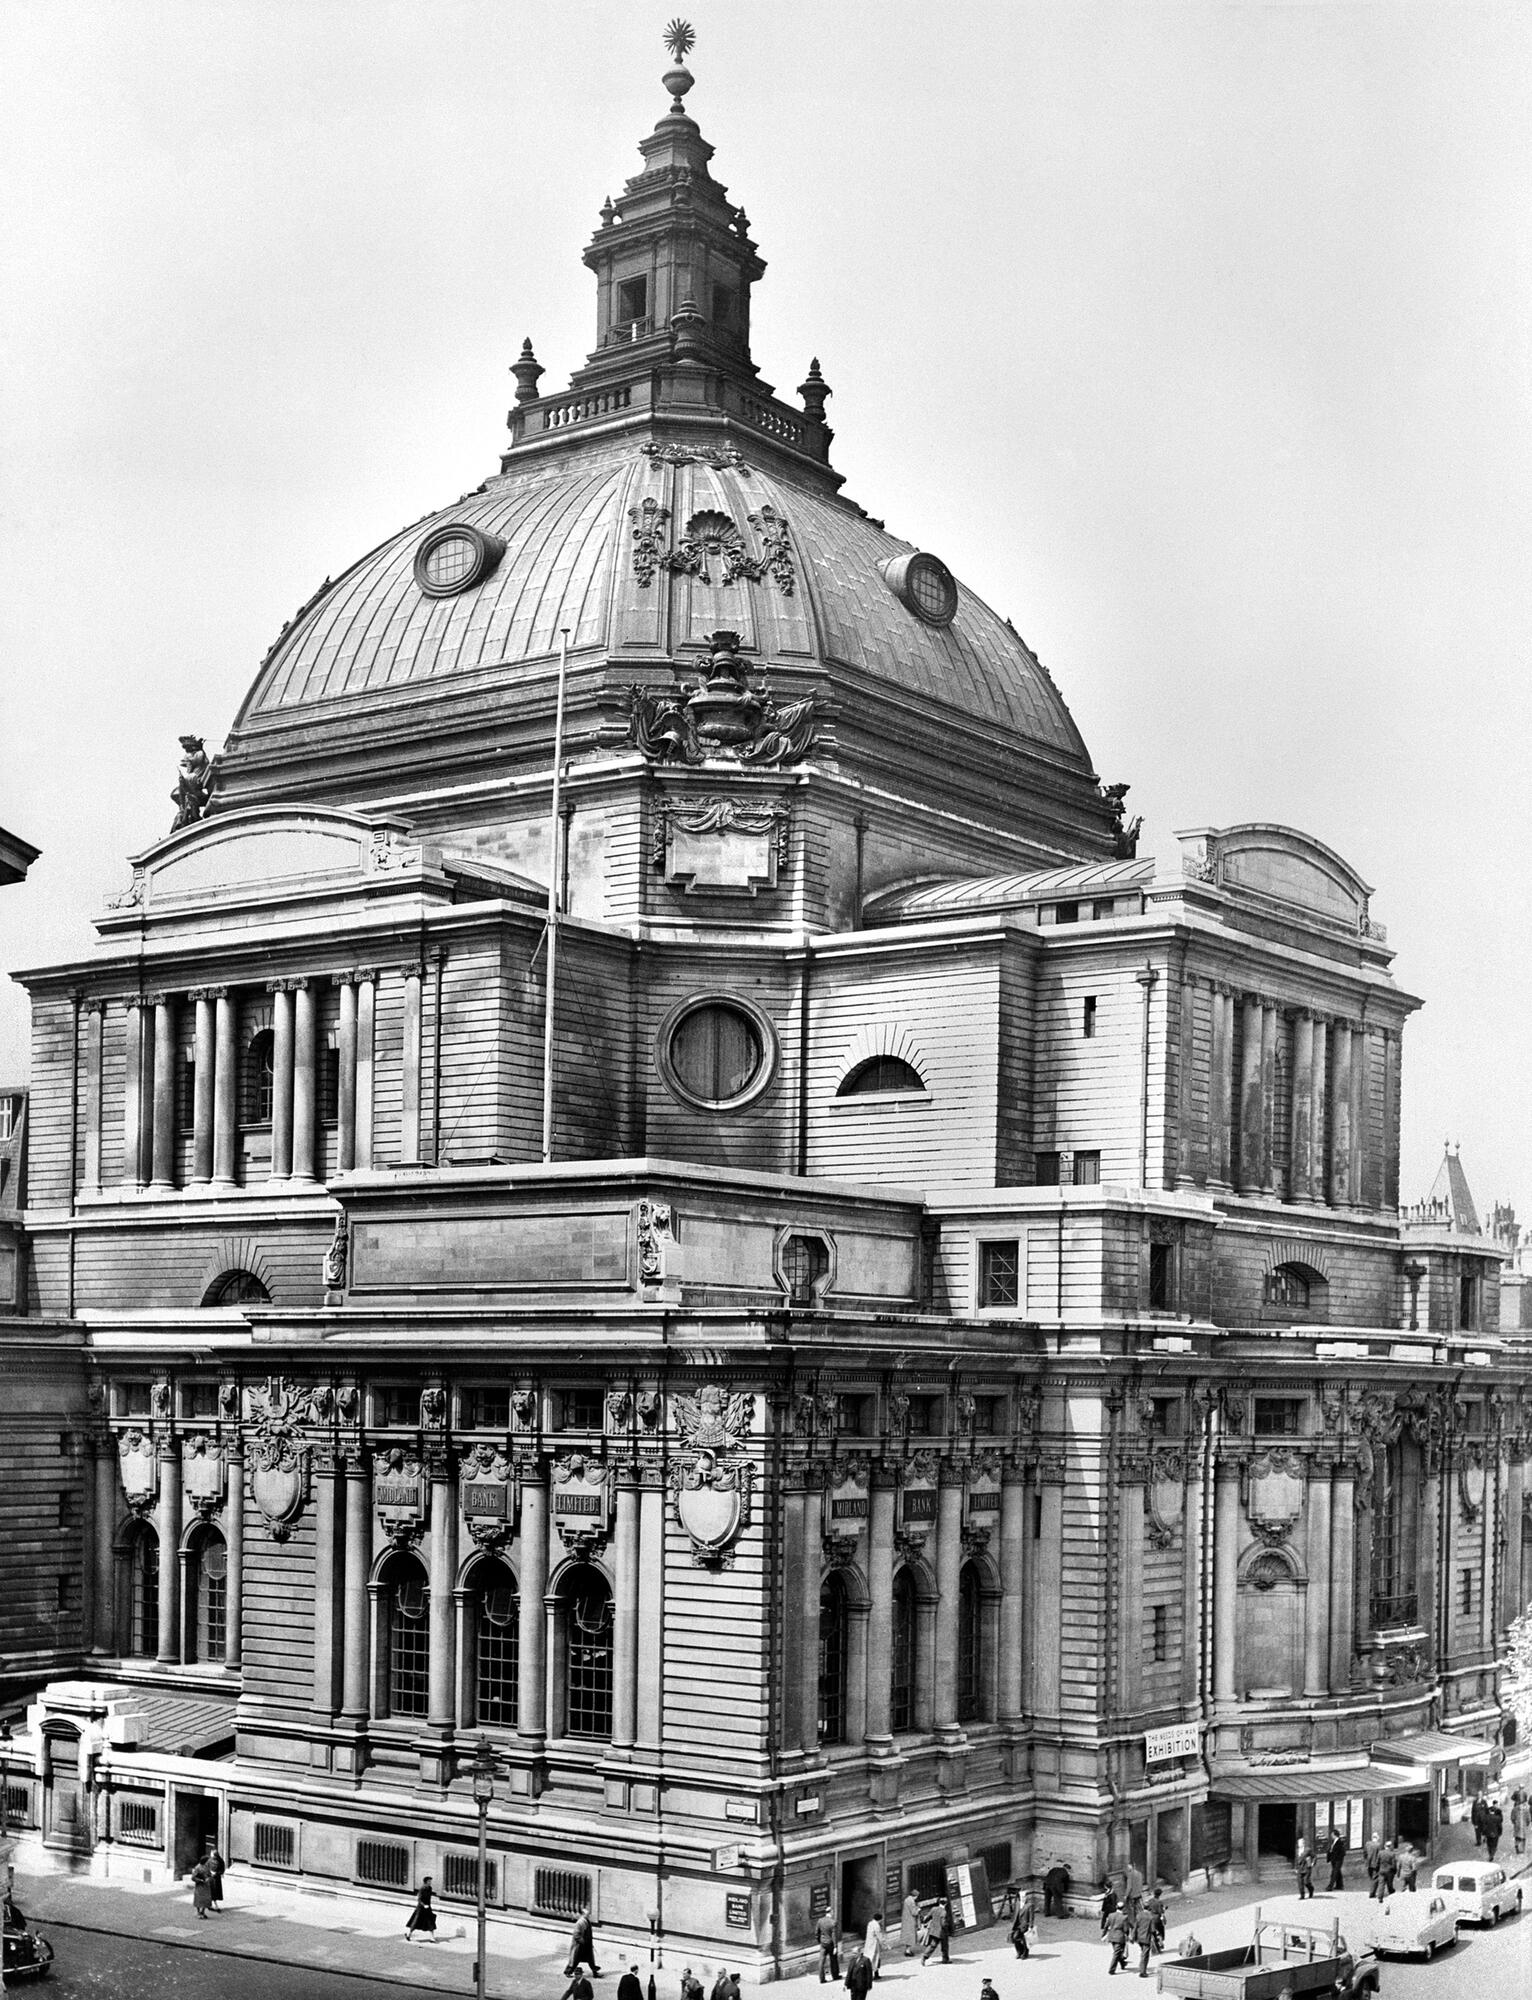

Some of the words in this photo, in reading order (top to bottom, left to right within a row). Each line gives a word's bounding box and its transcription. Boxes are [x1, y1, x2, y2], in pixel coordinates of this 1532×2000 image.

[379, 1487, 415, 1504] MIDLAND
[471, 1491, 497, 1509] BANK
[558, 1494, 597, 1513] LIMITED
[836, 1499, 866, 1517] MIDLAND
[912, 1498, 931, 1513] BANK
[974, 1494, 999, 1509] LIMITED
[1148, 1738, 1196, 1759] EXHIBITION
